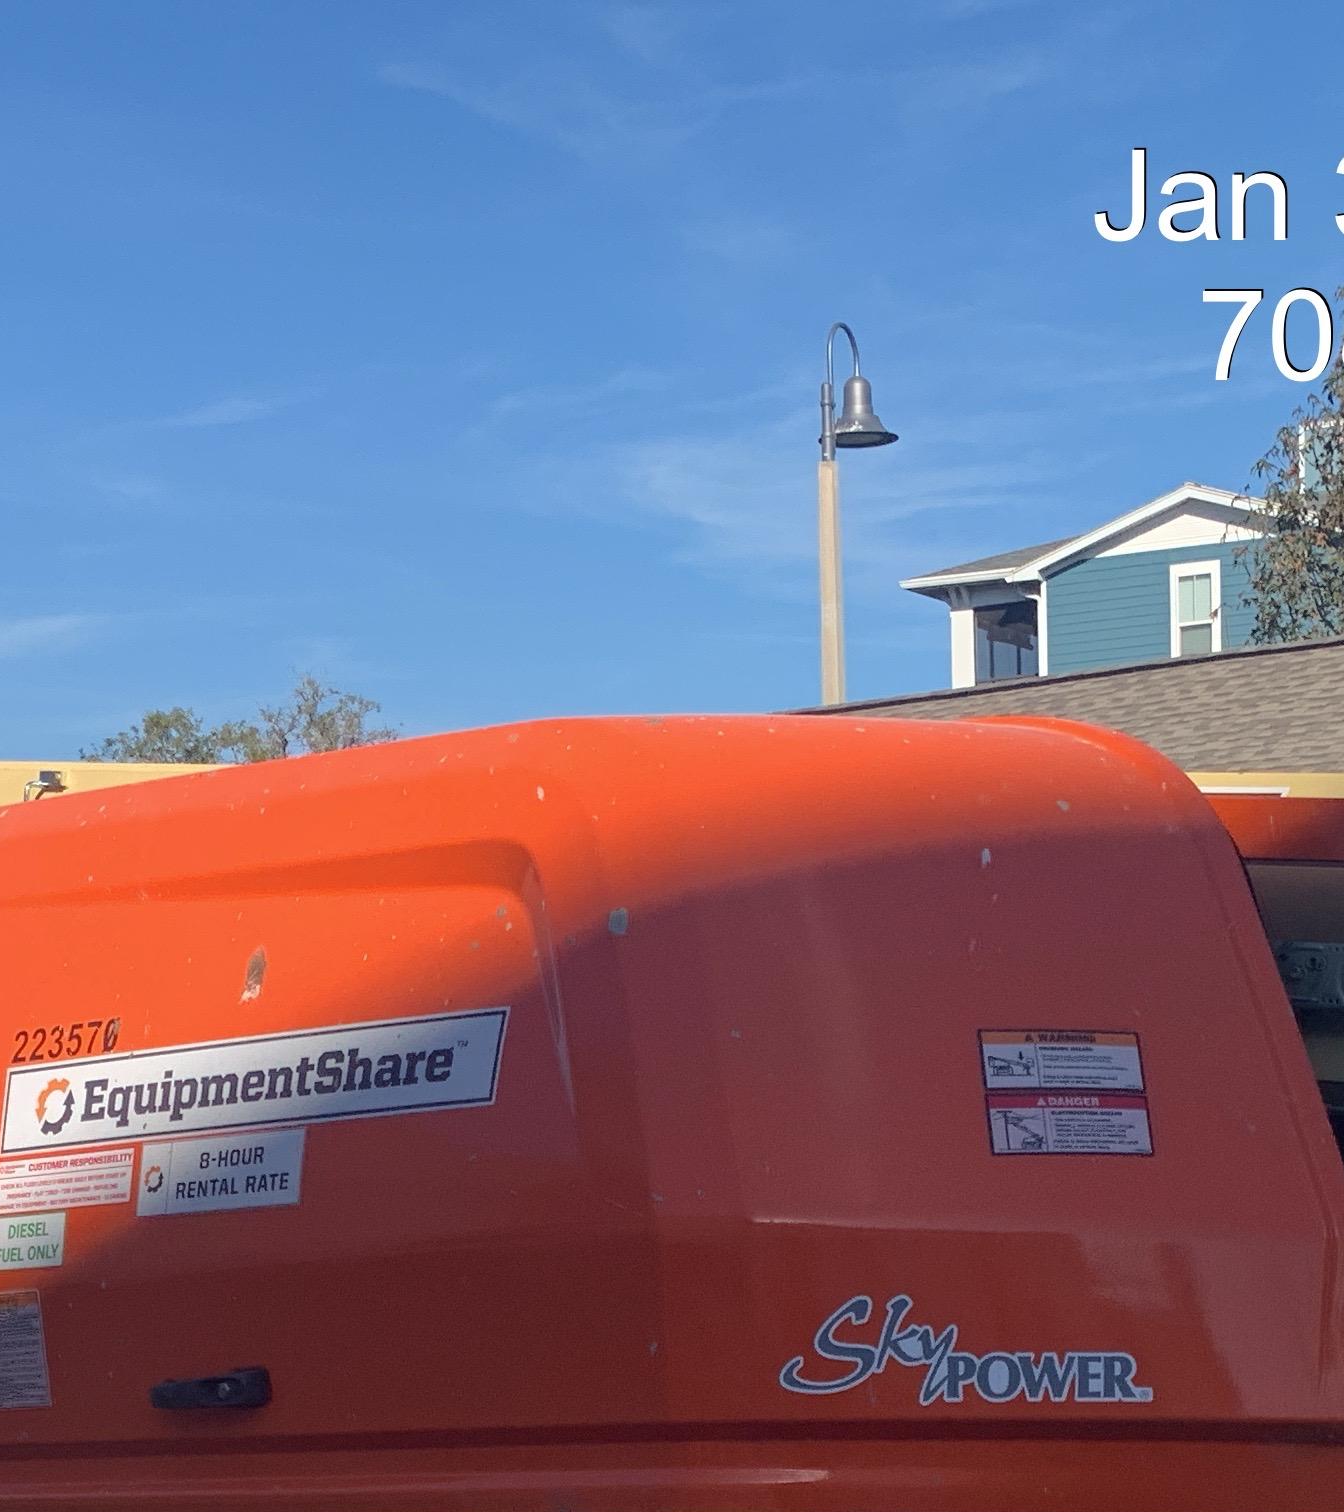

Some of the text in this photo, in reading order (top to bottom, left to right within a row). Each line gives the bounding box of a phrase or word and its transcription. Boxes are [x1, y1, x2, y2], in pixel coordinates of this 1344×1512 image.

[12, 1017, 120, 1063] 223570
[1048, 1096, 1100, 1107] DANGER
[28, 1159, 68, 1172] CUSTOMER
[69, 1153, 132, 1168] RESPONSIBILITY
[199, 1146, 265, 1169] 8-HOUR
[175, 1172, 290, 1200] RENTAL RATE
[8, 1222, 49, 1240] DIESEL
[27, 1243, 60, 1260] ONLY
